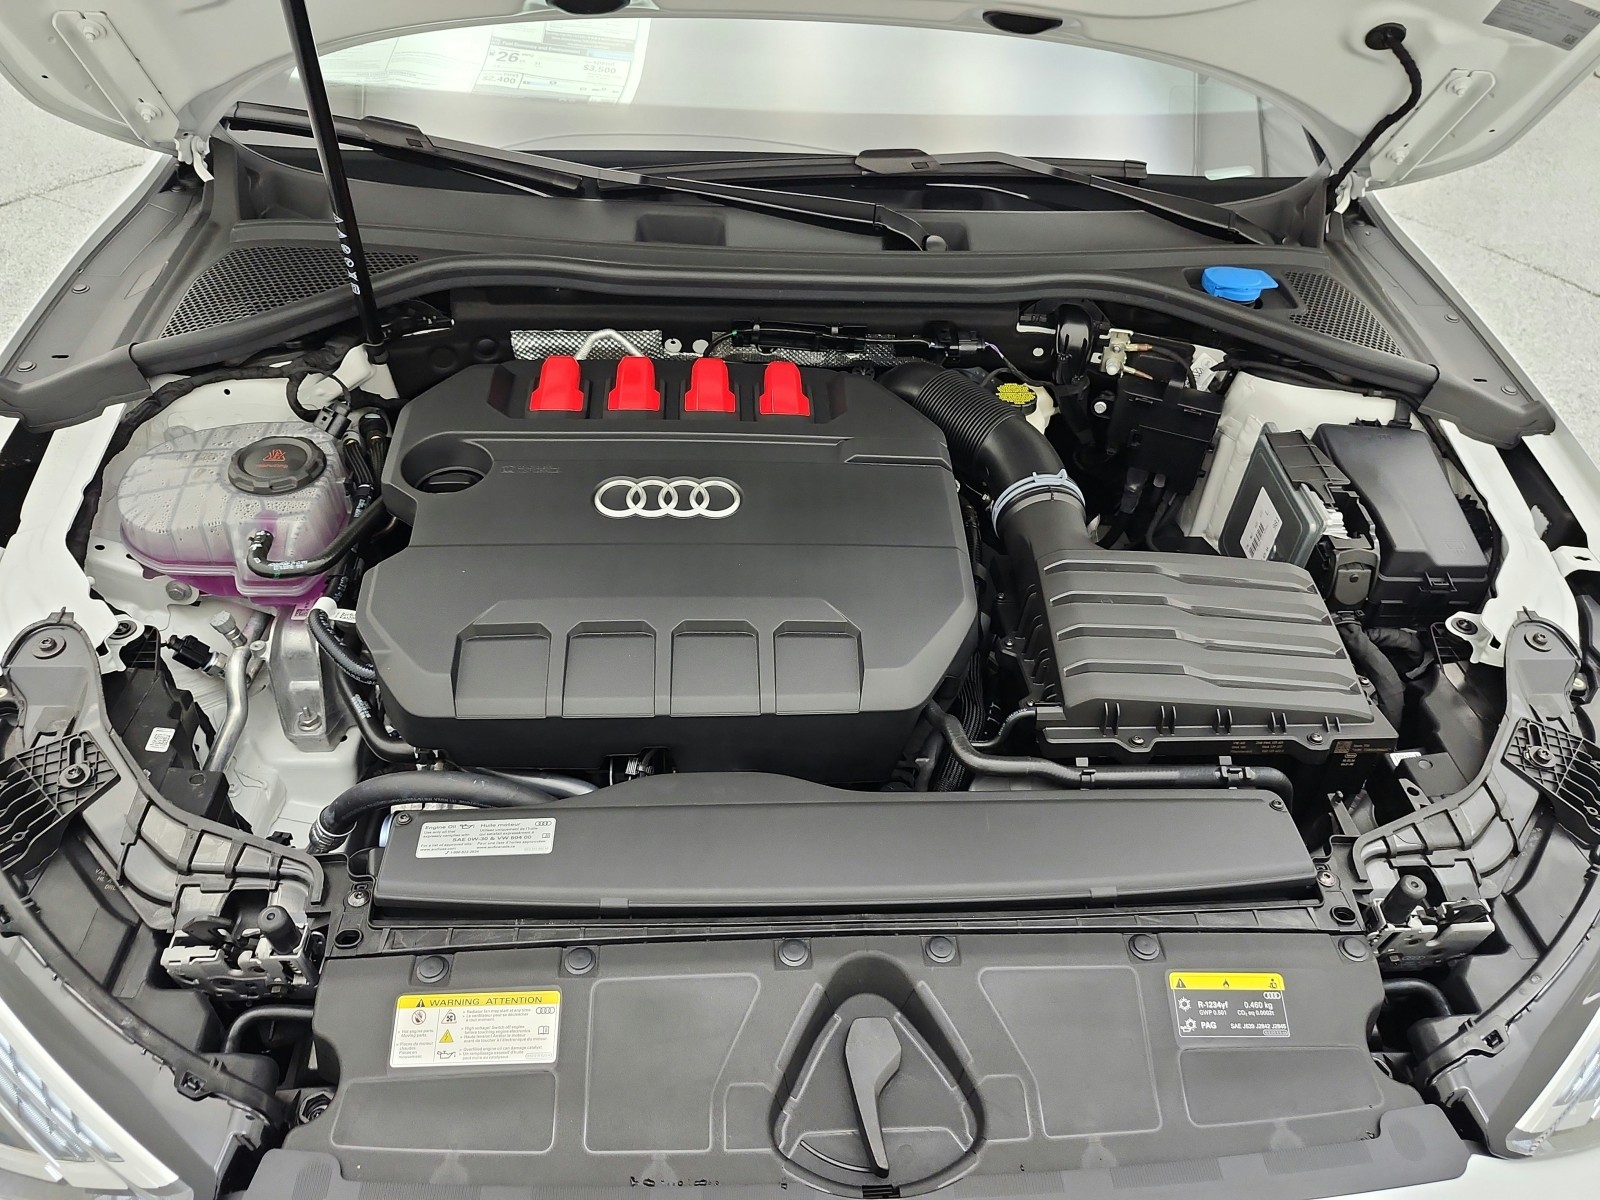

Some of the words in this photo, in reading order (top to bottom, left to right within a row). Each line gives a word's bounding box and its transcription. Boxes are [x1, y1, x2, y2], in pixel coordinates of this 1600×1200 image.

[496, 51, 520, 62] 26
[430, 998, 480, 1006] WARNING
[486, 996, 543, 1005] ATTENTION
[1197, 1000, 1228, 1010] R-1234yf
[1264, 1001, 1273, 1010] kg
